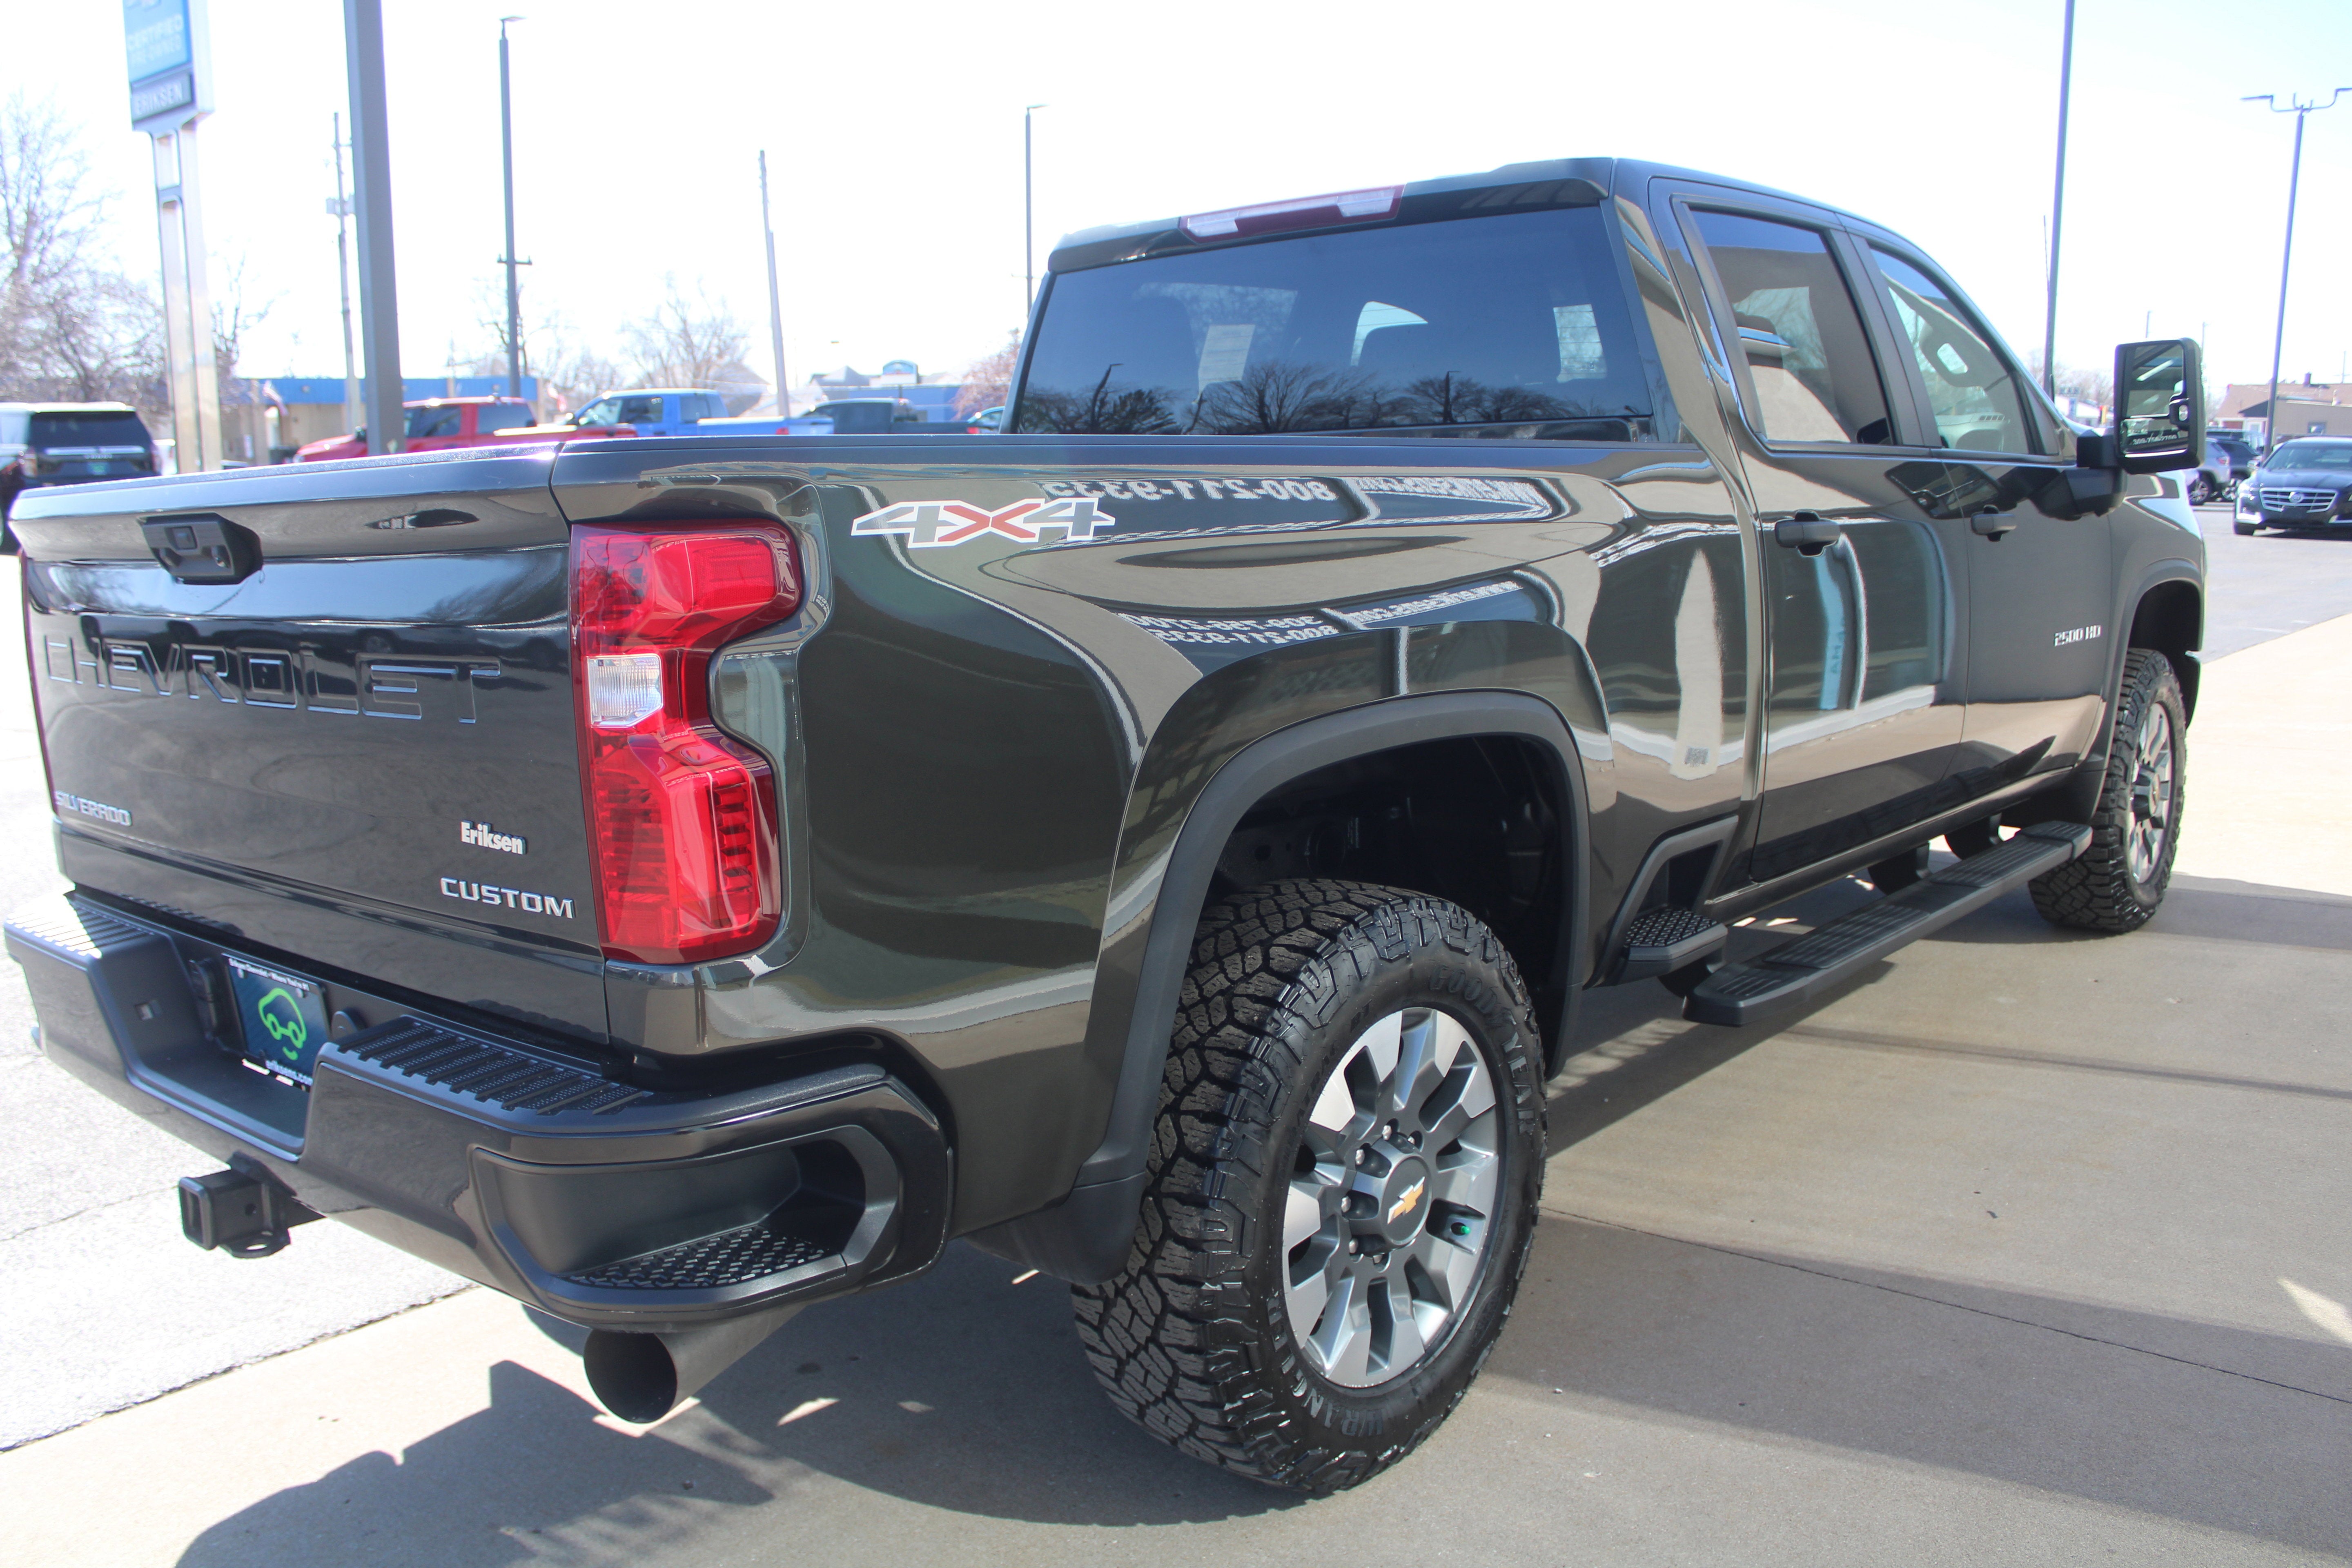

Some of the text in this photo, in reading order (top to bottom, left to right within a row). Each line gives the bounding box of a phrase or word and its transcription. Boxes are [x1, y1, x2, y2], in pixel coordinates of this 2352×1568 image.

[127, 13, 183, 51] CERTIFIED
[135, 82, 182, 115] ERIKSEN
[851, 497, 1116, 549] 4X4
[2054, 624, 2102, 647] 2500 HD
[45, 634, 502, 724] CHEVROLET
[55, 790, 132, 827] SILVERADO
[460, 820, 527, 855] Eriksen
[440, 877, 577, 919] CUSTOM
